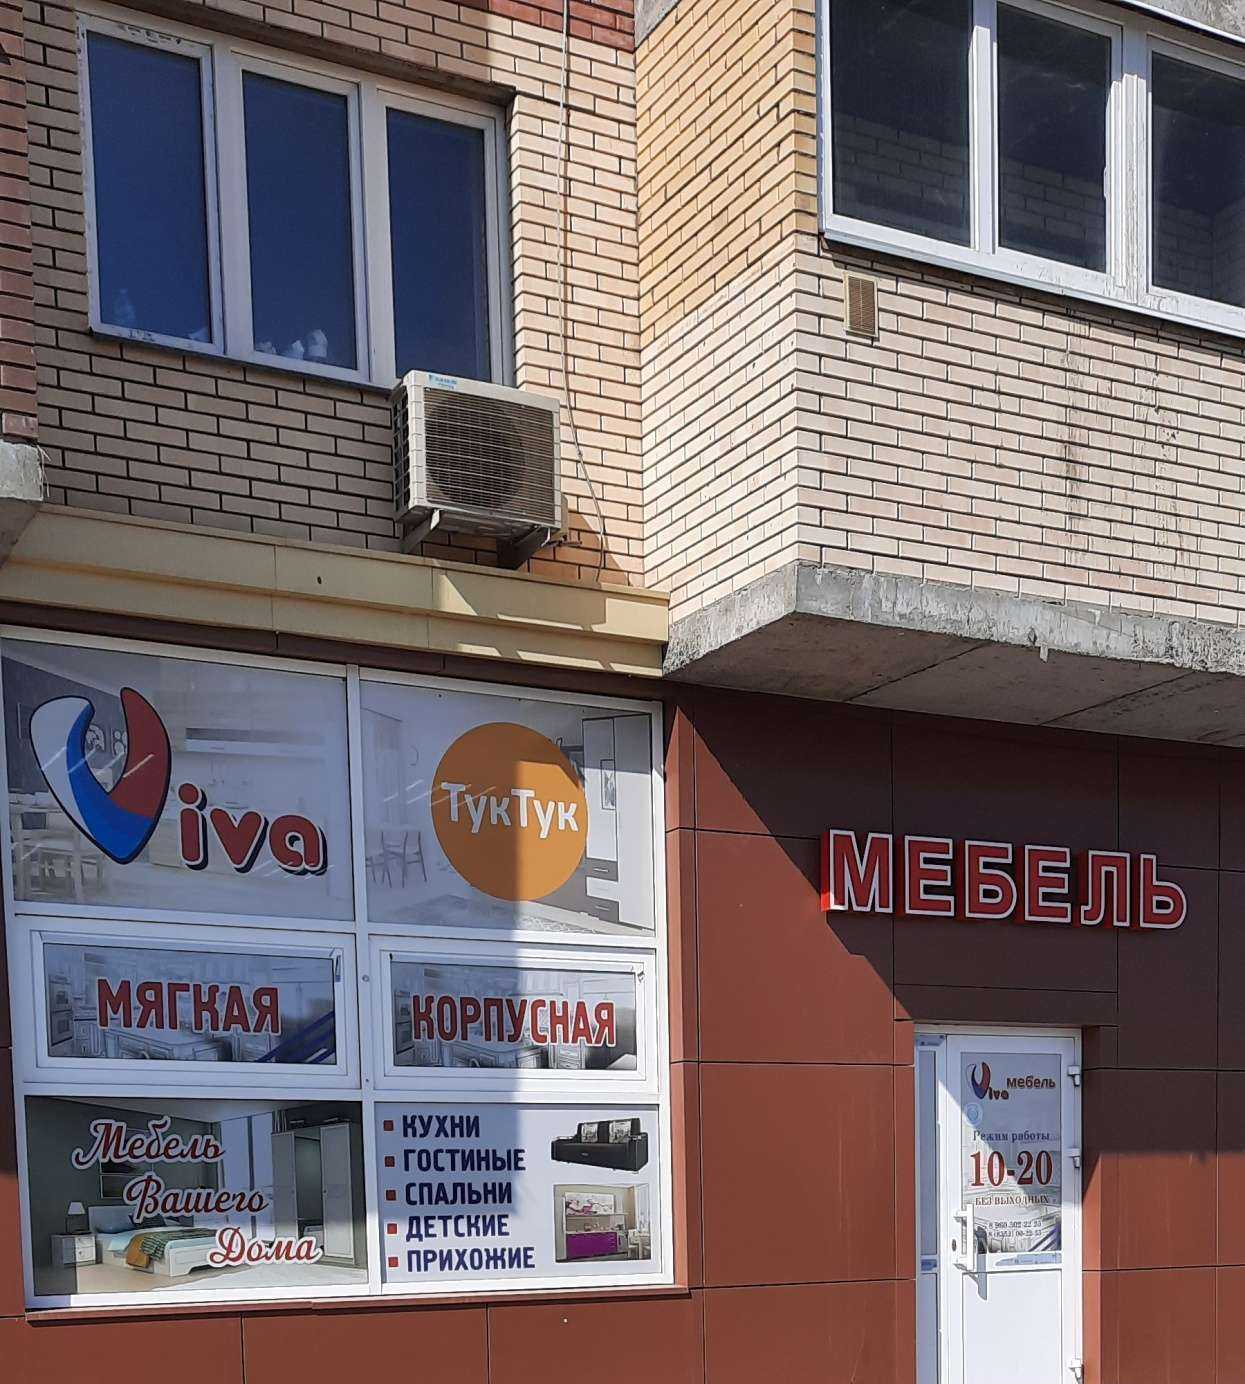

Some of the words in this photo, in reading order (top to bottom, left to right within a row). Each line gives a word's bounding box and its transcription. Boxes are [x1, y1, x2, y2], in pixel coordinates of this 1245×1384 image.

[29, 686, 329, 875] Viva
[441, 781, 580, 839] ТукТук
[822, 828, 1187, 929] МЕБЕЛЬ
[96, 977, 281, 1035] МЯГКАЯ
[412, 994, 617, 1046] КОРПУСНАЯ
[1006, 1075, 1056, 1089] мебель
[73, 1117, 225, 1168] Мебель
[402, 1115, 480, 1138] КУХНИ
[973, 1130, 1008, 1140] Режим
[1012, 1130, 1050, 1142] работы
[403, 1148, 526, 1172] ГОСТИНЫЕ
[970, 1150, 1053, 1187] 10-20
[125, 1174, 270, 1223] Вашего
[405, 1182, 513, 1205] СПАЛЬНИ
[209, 1226, 321, 1266] Дома
[406, 1214, 511, 1242] ДЕТСКИЕ
[407, 1246, 535, 1272] ПРИХОЖИЕ
